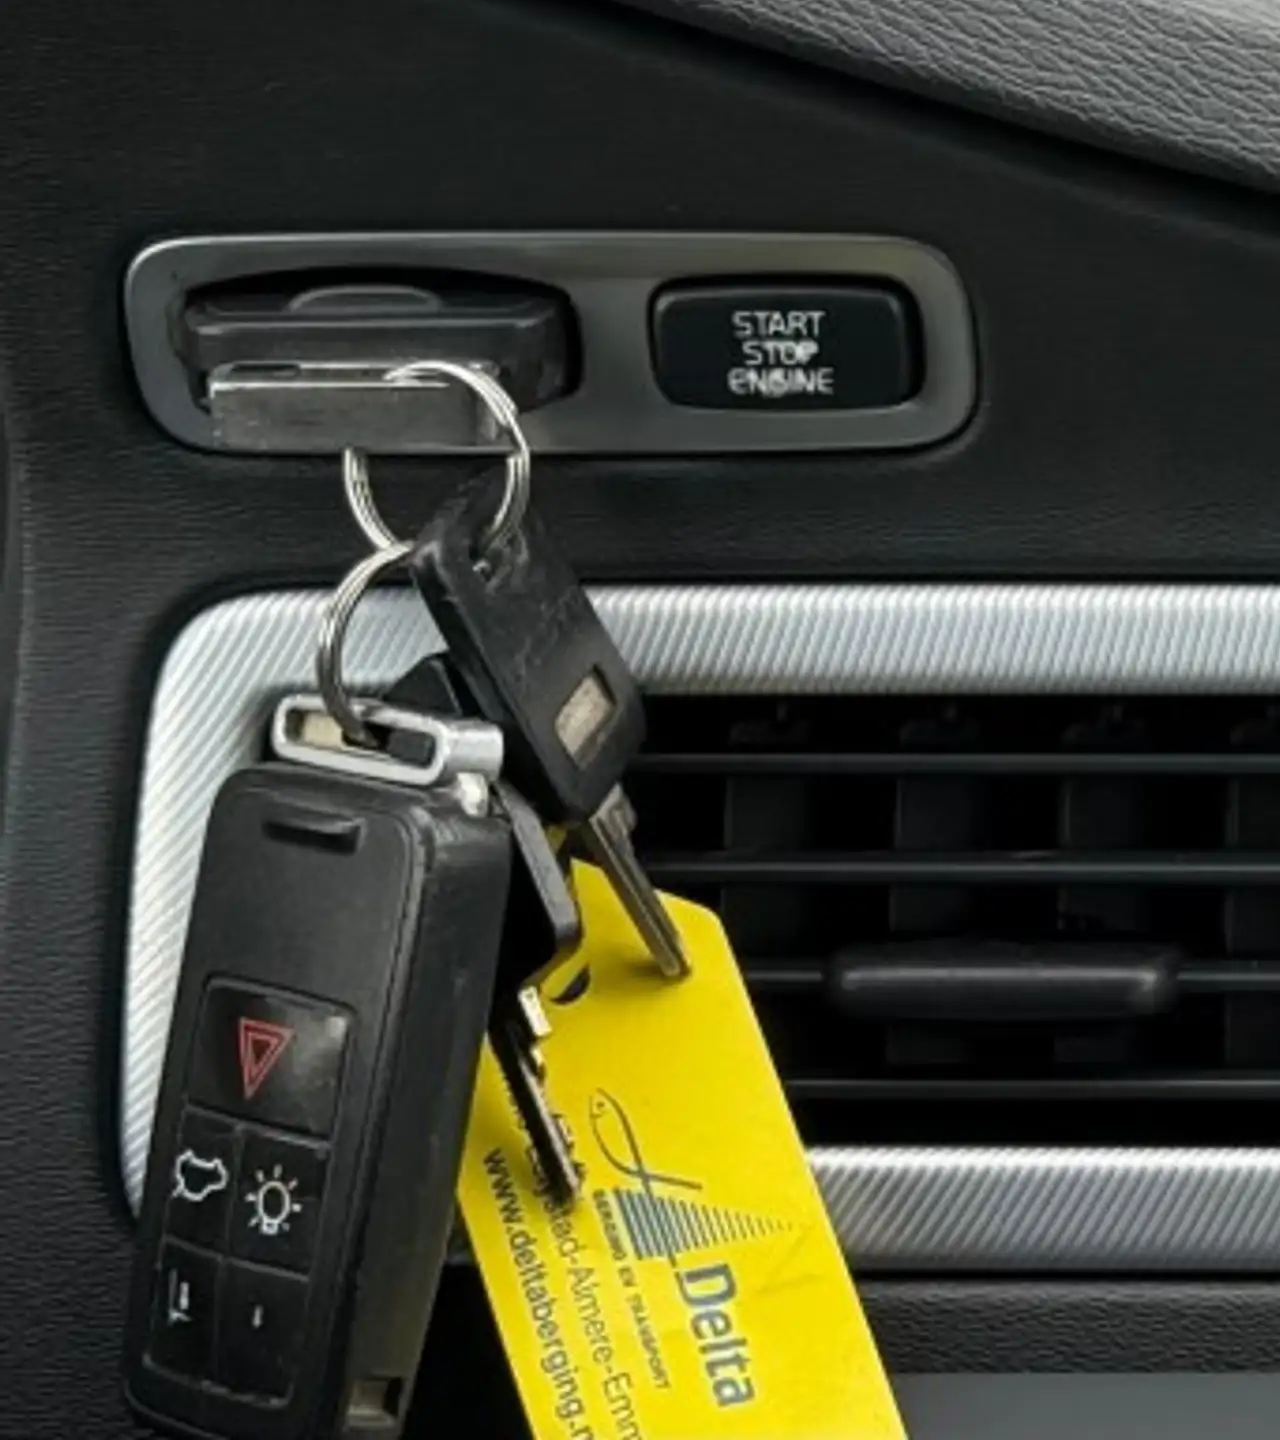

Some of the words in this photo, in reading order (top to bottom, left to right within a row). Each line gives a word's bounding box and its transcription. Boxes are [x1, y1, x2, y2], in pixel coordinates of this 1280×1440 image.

[731, 310, 826, 338] START
[741, 340, 820, 366] STOP
[727, 366, 835, 398] ENGINE
[674, 1263, 756, 1408] Delta
